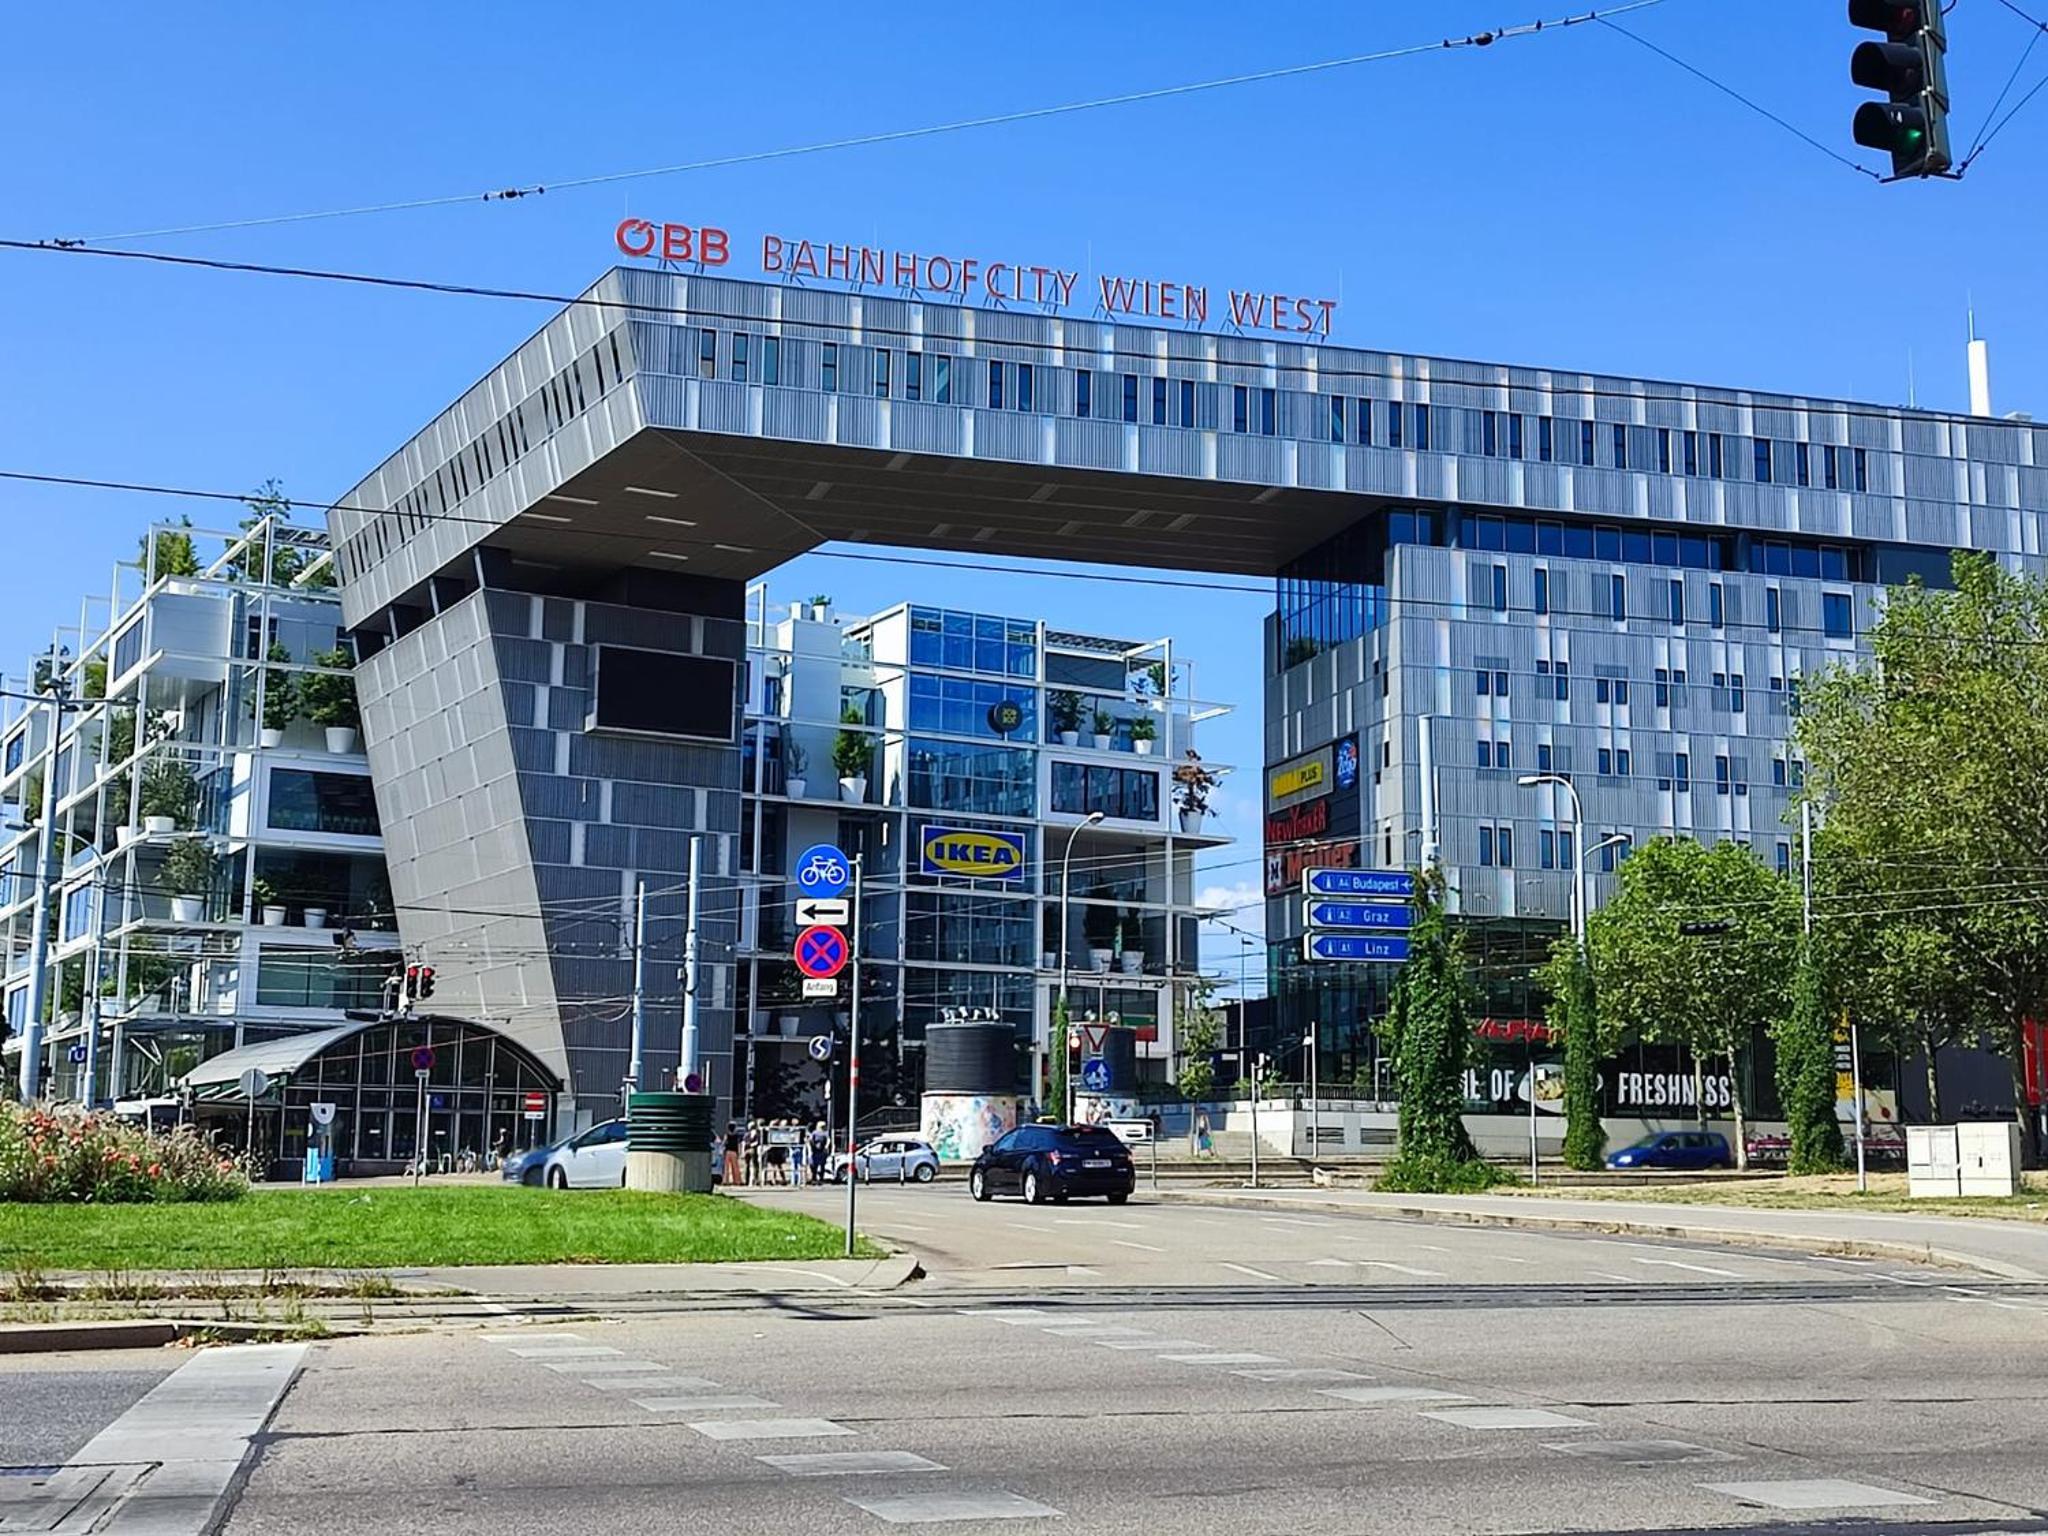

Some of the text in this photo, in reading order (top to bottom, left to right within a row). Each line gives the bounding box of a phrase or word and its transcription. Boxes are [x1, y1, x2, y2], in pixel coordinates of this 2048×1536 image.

[615, 218, 1337, 336] ÖBB BAHNHOFCITY WIEN WEST
[1301, 765, 1318, 784] PLUS
[934, 842, 1015, 865] IKEA
[1353, 877, 1399, 892] Budapest
[1363, 909, 1390, 923] Graz
[1364, 941, 1390, 954] Linz
[806, 982, 834, 993] Anfang
[74, 1049, 85, 1061] U
[1490, 1067, 1516, 1102] OF
[1618, 1071, 1731, 1107] FRESHNSS
